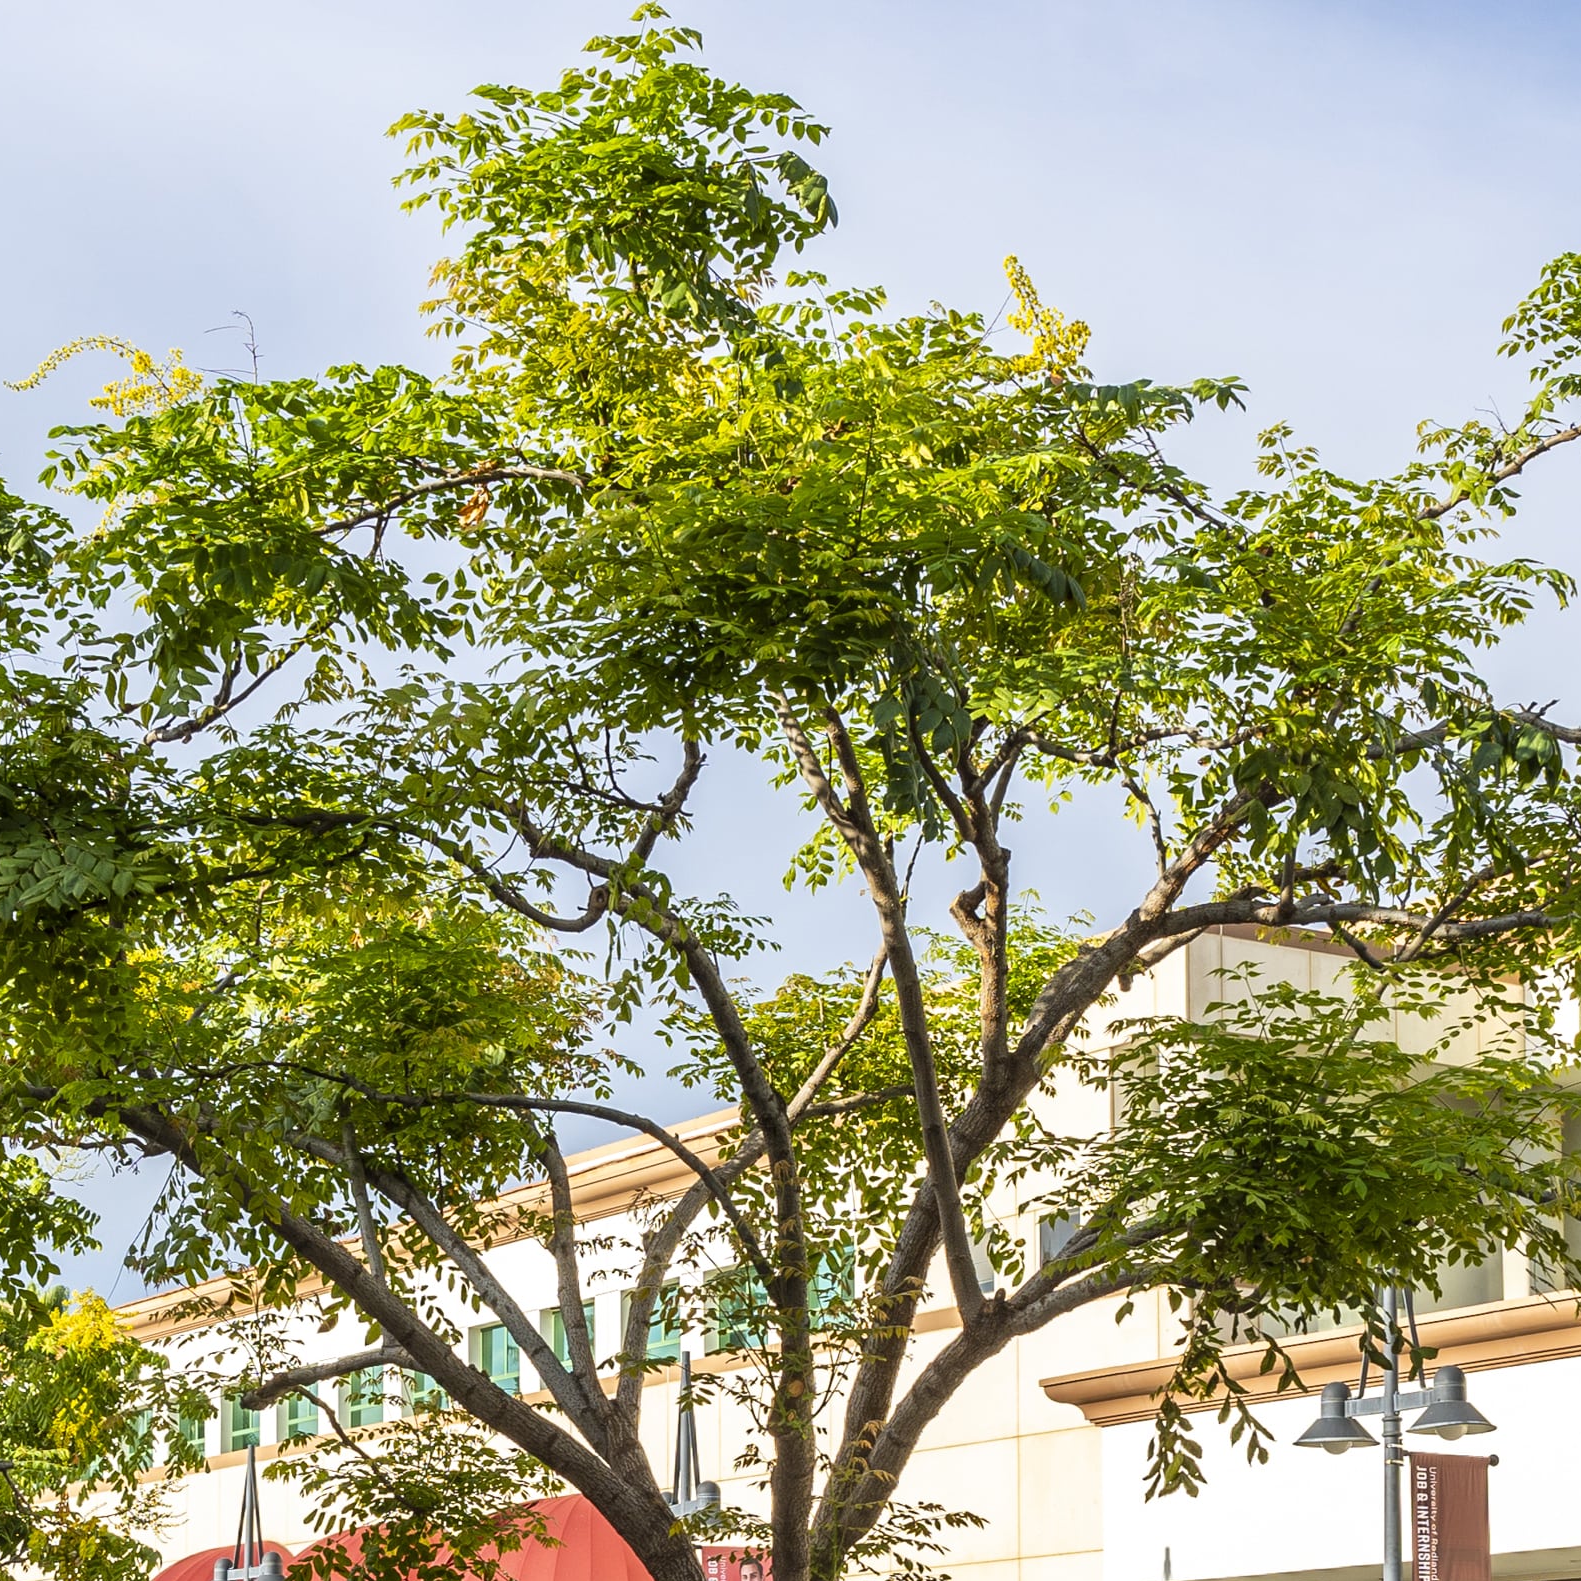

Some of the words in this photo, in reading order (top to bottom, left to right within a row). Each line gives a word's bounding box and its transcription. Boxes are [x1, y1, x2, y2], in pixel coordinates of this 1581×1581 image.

[1416, 1465, 1428, 1489] JOB
[1417, 1493, 1428, 1501] &
[1429, 1466, 1439, 1521] University
[1431, 1523, 1439, 1536] of
